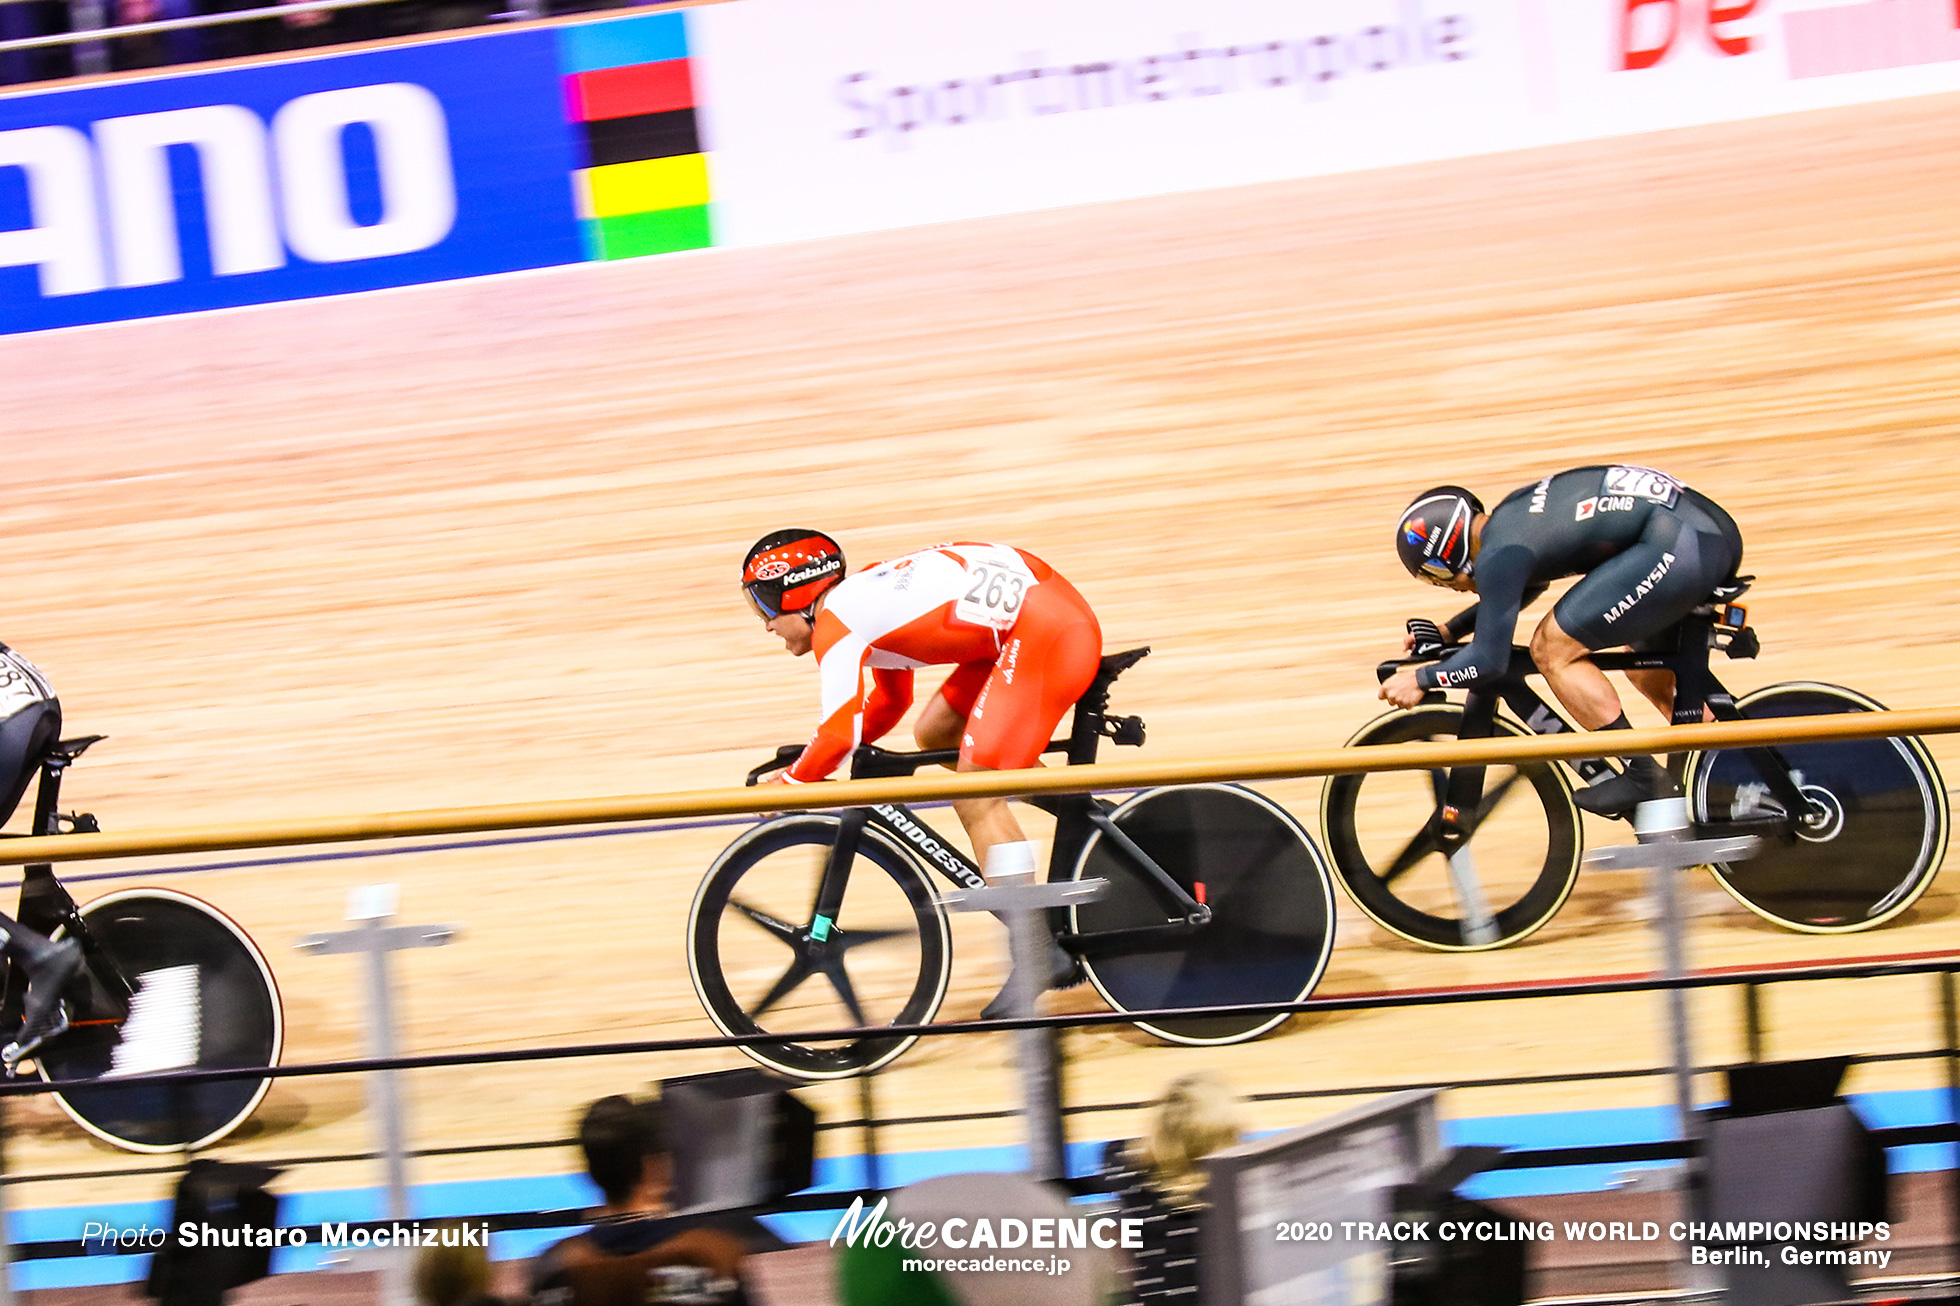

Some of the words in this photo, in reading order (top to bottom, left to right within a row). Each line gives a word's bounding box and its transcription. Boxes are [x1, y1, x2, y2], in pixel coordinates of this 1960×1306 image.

[834, 4, 1480, 152] Sportmetropole
[1608, 469, 1669, 497] 278
[1597, 496, 1635, 513] CIMB
[782, 559, 841, 587] Kabuto
[963, 566, 1025, 614] 263
[1602, 552, 1676, 624] MALAYSIA
[1449, 665, 1479, 684] CIMB
[871, 803, 988, 890] BRIDGESTO
